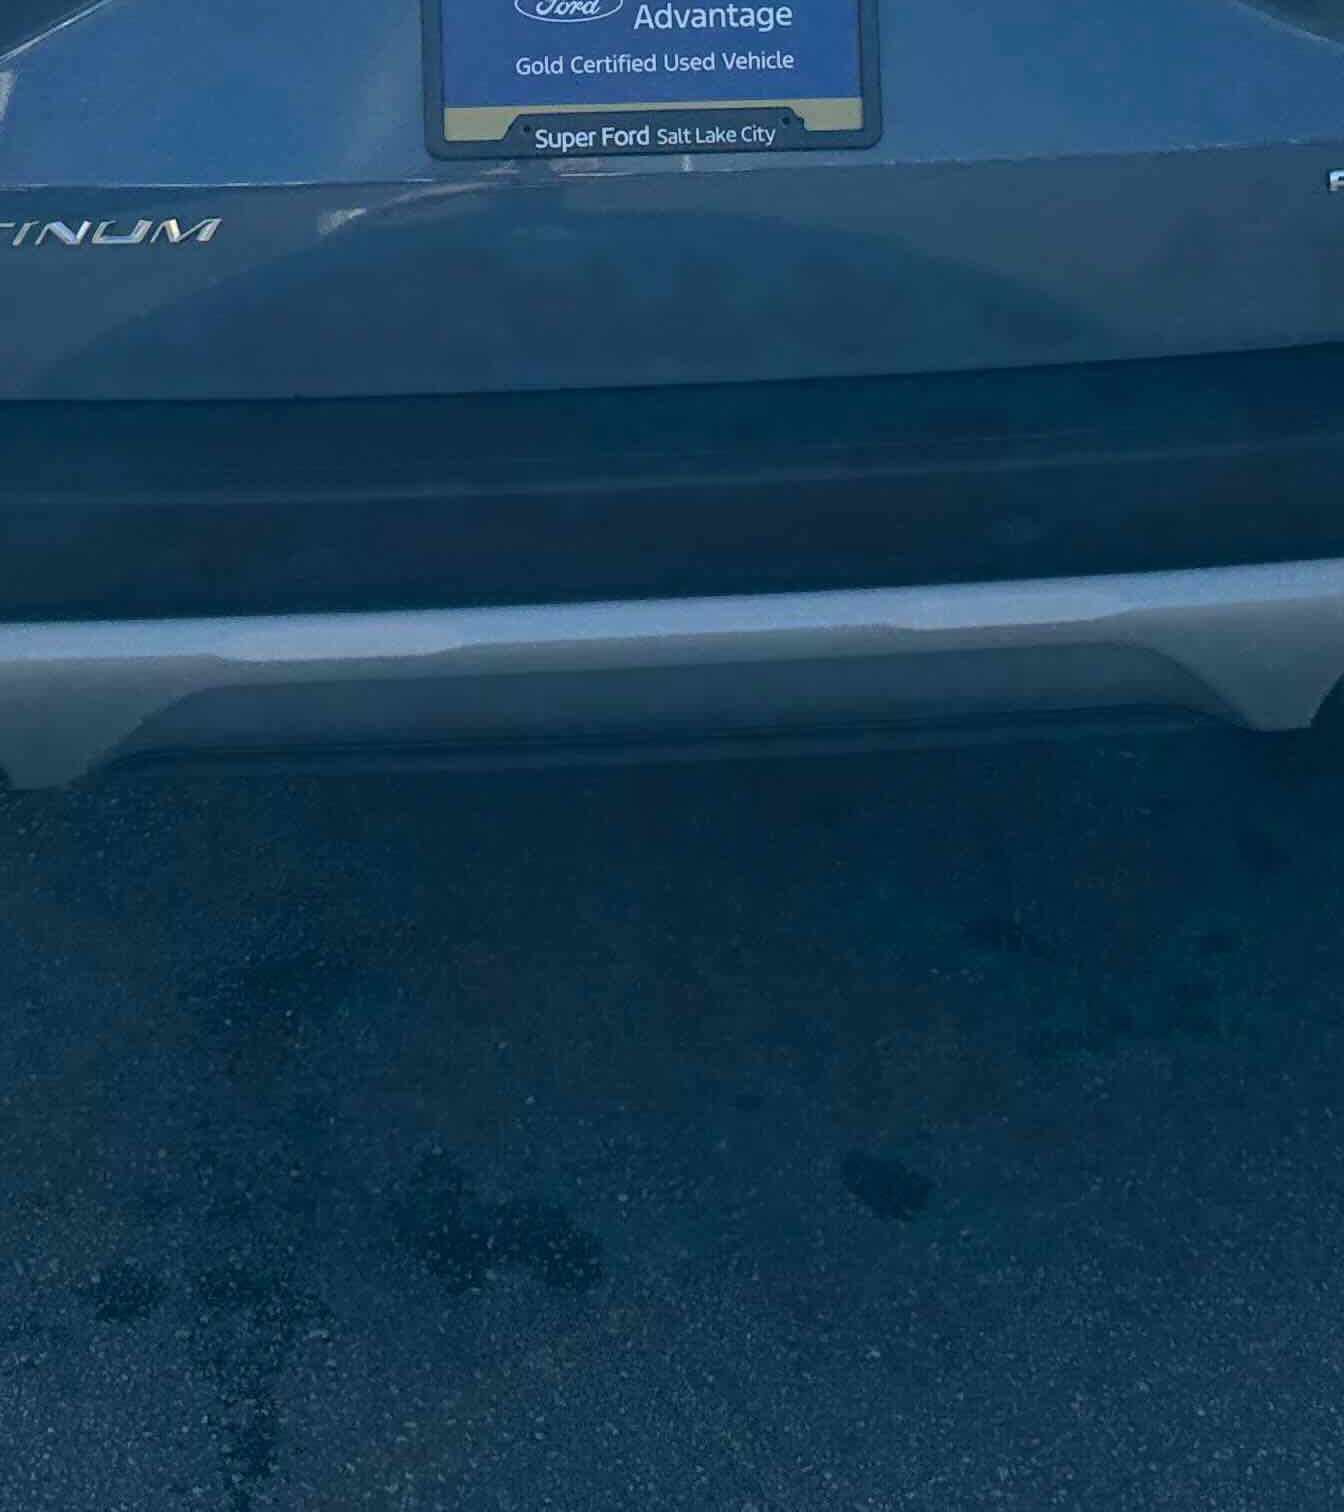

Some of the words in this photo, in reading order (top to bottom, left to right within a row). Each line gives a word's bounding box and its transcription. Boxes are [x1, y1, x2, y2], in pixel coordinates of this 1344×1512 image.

[634, 3, 793, 32] Advantage
[515, 56, 564, 75] Gold
[570, 54, 657, 74] Certified
[664, 52, 716, 72] Used
[722, 50, 794, 70] Vehicle
[535, 128, 597, 153] Super
[602, 125, 650, 147] Ford
[657, 127, 691, 145] Salt
[695, 126, 737, 144] Lake
[741, 124, 776, 144] City
